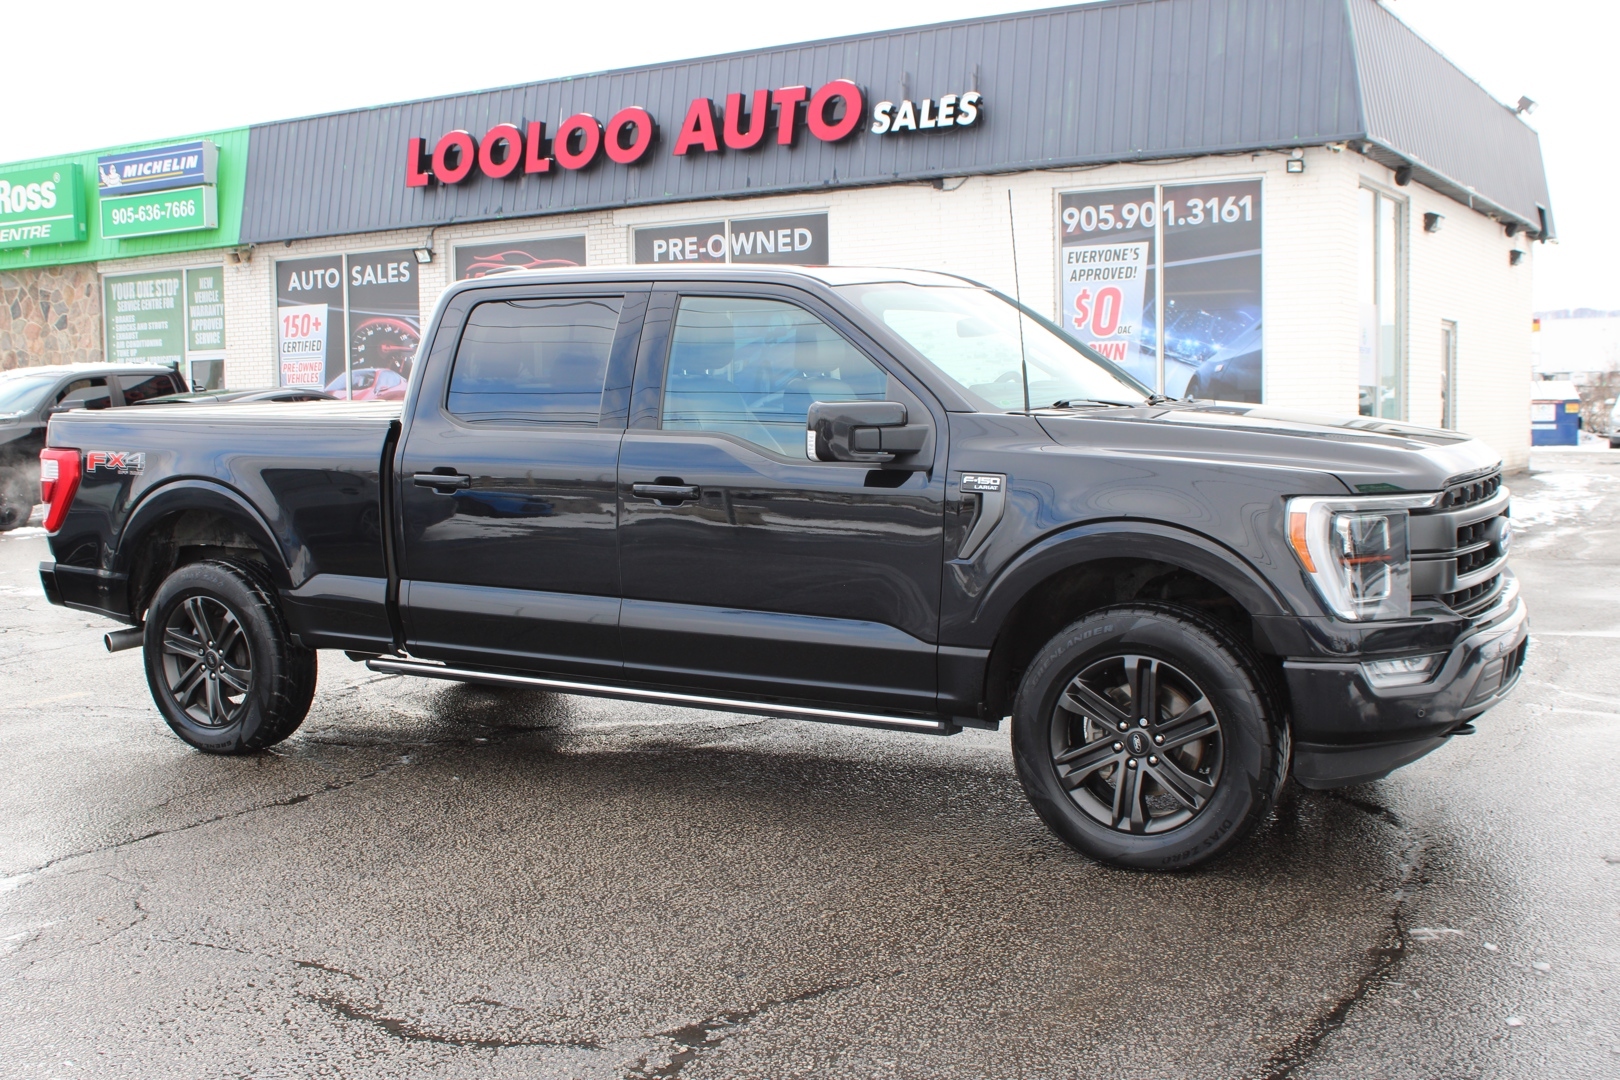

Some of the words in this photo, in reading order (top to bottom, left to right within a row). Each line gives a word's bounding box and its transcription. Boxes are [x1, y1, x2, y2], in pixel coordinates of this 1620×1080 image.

[405, 105, 655, 188] LOOLOO
[672, 78, 866, 157] AUTO
[871, 91, 982, 135] SALES
[123, 155, 198, 177] MICHELIN
[112, 199, 196, 225] 905-636-7666
[1062, 194, 1253, 233] 905.901.3161
[0, 224, 51, 242] ENTRE
[653, 228, 813, 262] PRE-OWNED
[1067, 247, 1140, 265] EVERYONE'S
[288, 268, 340, 292] AUTO
[351, 261, 411, 287] SALES
[1070, 266, 1137, 282] APPROVED!
[111, 282, 135, 300] YOUR
[136, 280, 154, 299] ONE
[156, 278, 179, 296] STOP
[199, 277, 213, 290] NEW
[117, 300, 140, 312] SERVICE
[141, 298, 162, 311] CENTRE
[163, 297, 174, 309] FOR
[194, 290, 219, 304] VEHICLE
[190, 303, 224, 318] WARRANTY
[1074, 286, 1123, 336] $0
[1117, 325, 1133, 335] OAC
[137, 322, 148, 331] AND
[148, 321, 168, 330] STRUTS
[191, 317, 223, 331] APPROVED
[283, 313, 322, 338] 150+
[195, 332, 221, 345] SERVICE
[282, 340, 322, 354] CERTIFIED
[282, 362, 322, 374] PRE-OWNED
[286, 373, 319, 385] VEHICLES
[87, 450, 146, 473] FX4
[963, 476, 1001, 485] F-150
